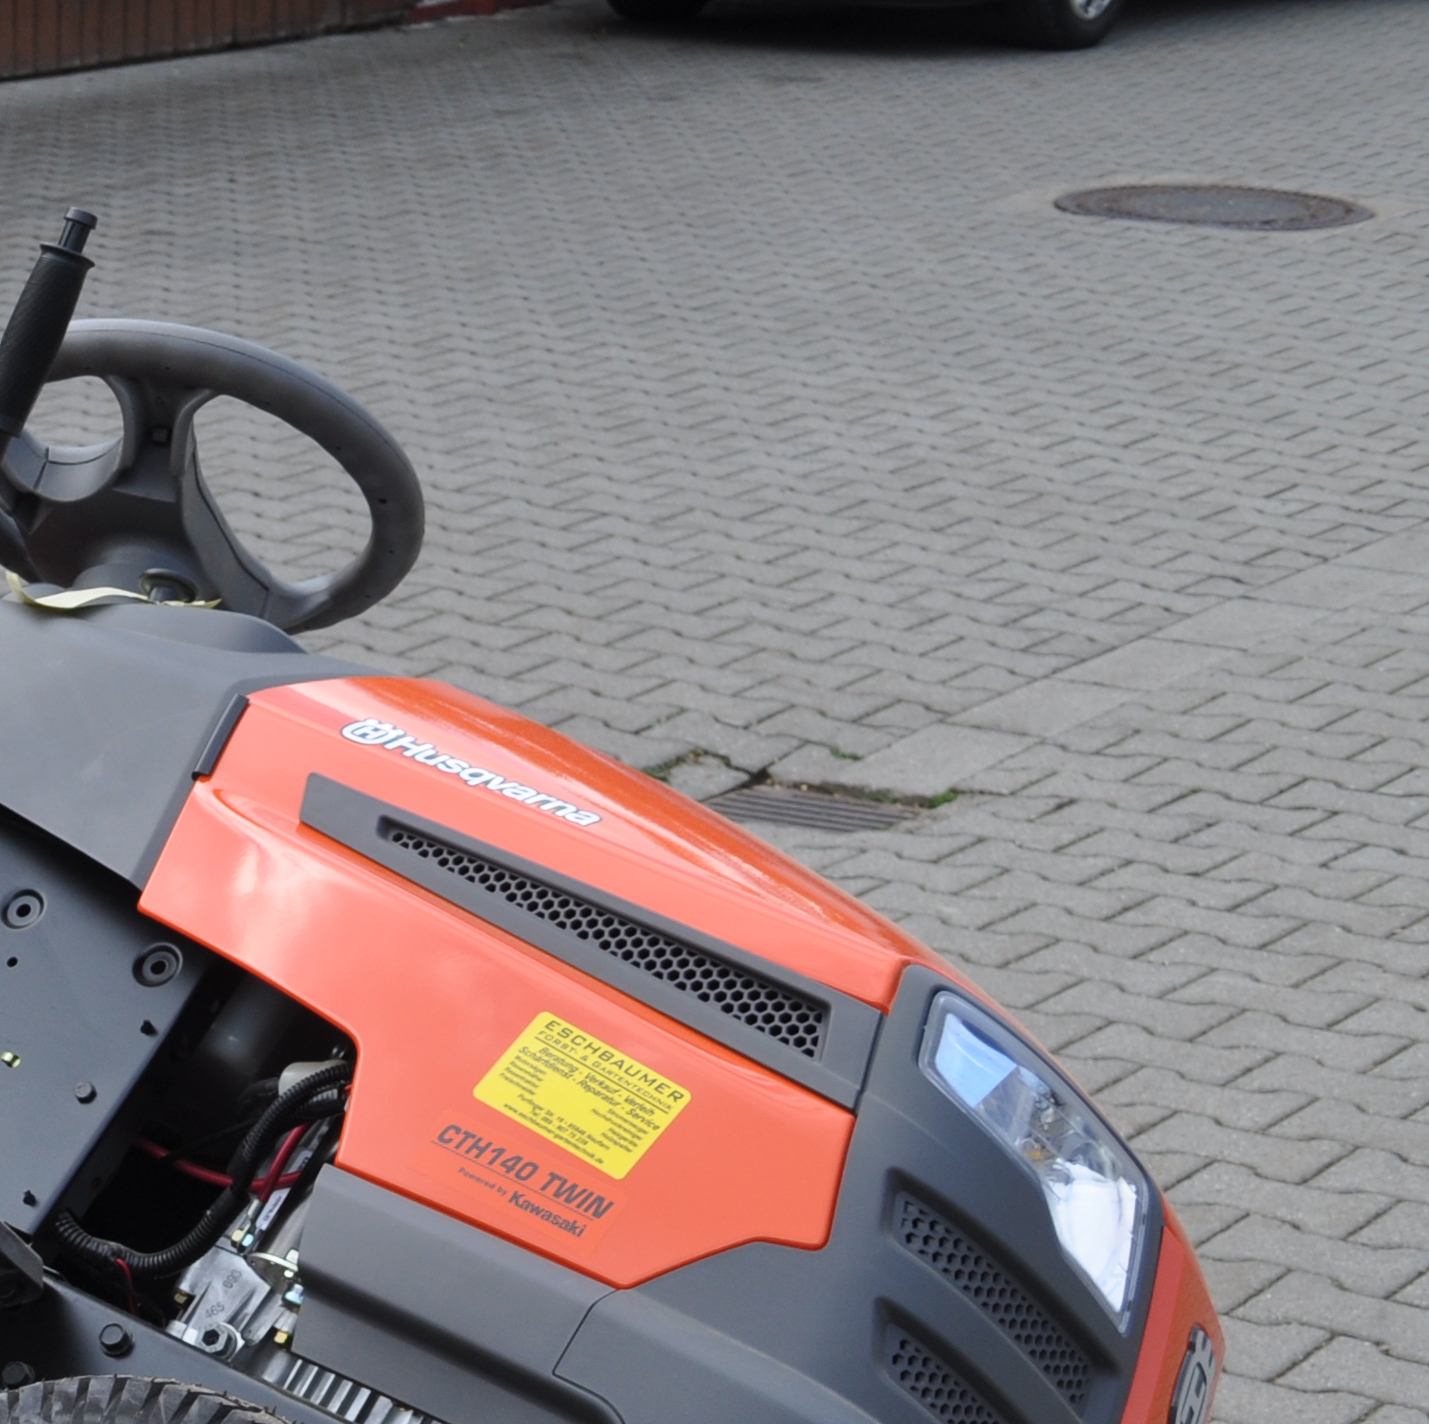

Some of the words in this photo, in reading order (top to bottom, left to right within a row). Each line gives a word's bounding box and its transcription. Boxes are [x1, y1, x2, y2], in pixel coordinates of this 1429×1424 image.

[387, 733, 602, 827] Husqvarna
[544, 1019, 685, 1103] ESCHBAUMER
[626, 1108, 661, 1131] Service
[436, 1123, 540, 1182] CTH140
[540, 1171, 615, 1220] TWIN
[458, 1166, 497, 1190] Powered
[508, 1190, 588, 1238] Kawasaki
